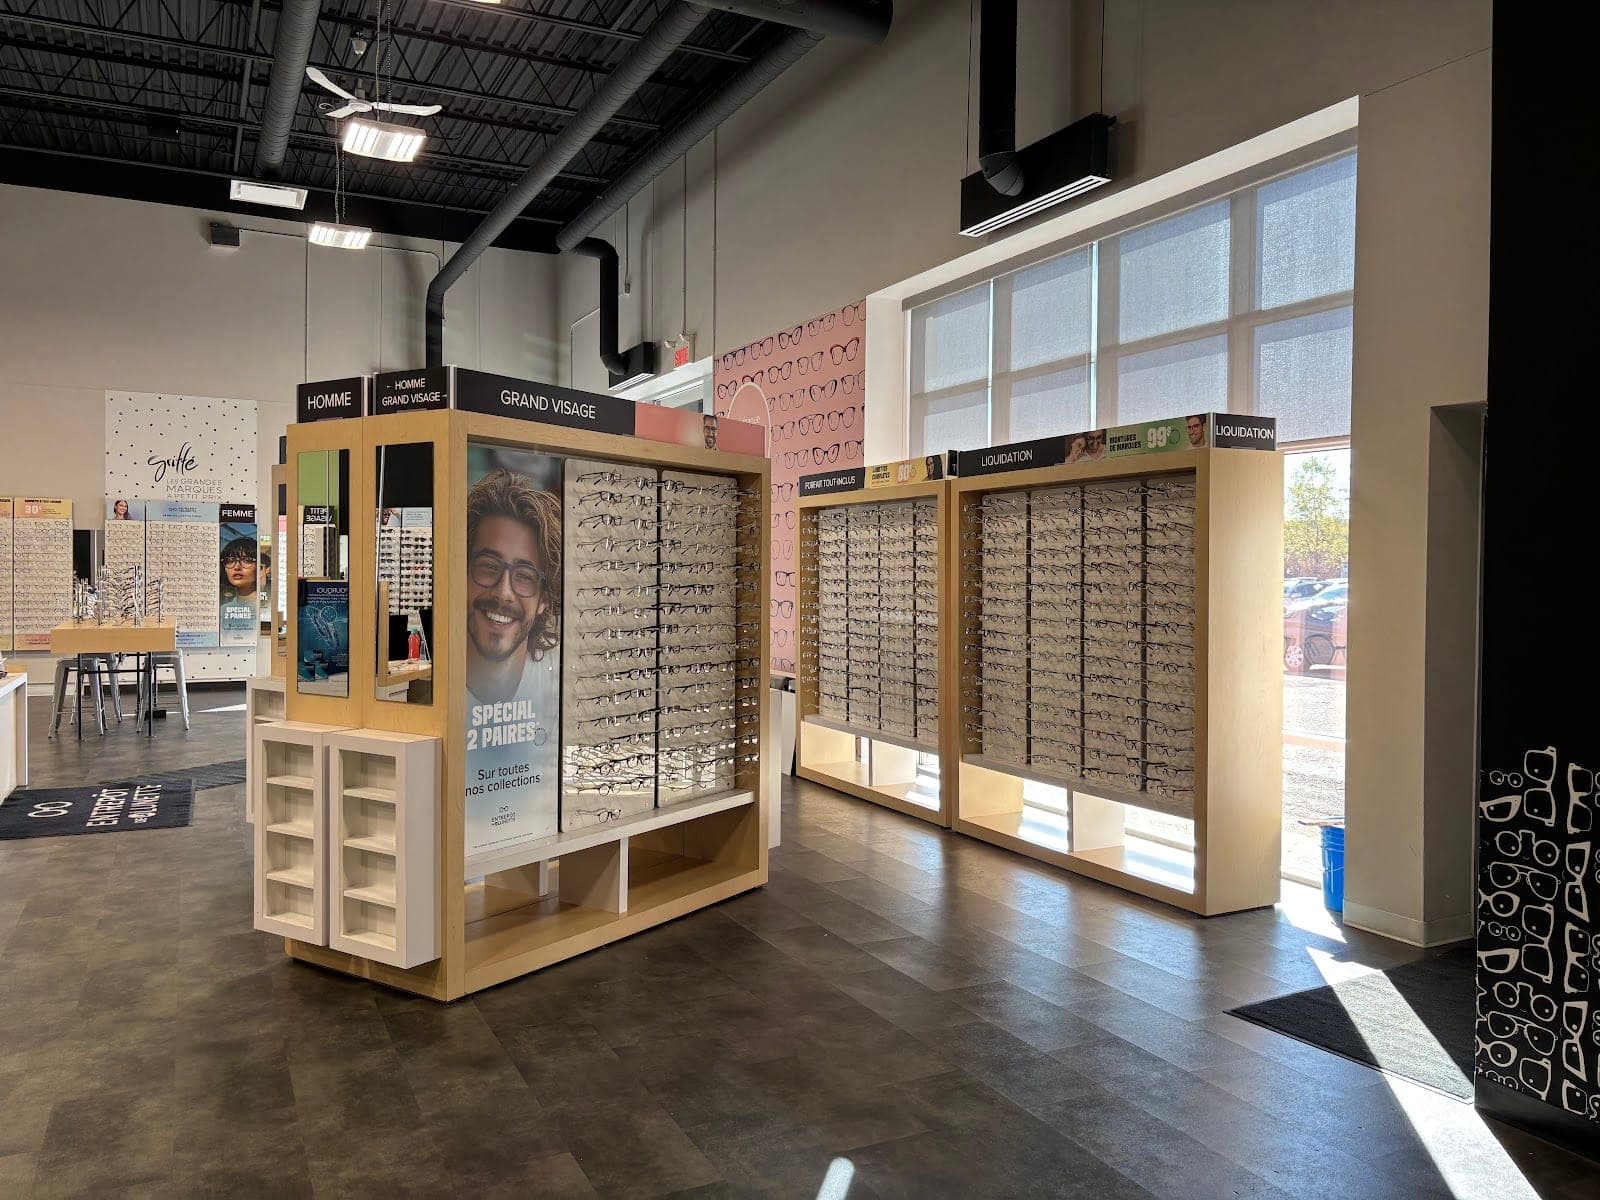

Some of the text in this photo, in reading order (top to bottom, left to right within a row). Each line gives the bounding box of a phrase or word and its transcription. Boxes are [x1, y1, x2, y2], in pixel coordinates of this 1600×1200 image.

[394, 377, 426, 390] HOMME
[307, 391, 352, 410] HOMME
[381, 391, 441, 407] GRAND VISAGE
[500, 389, 596, 420] GRAND VISAGE
[1215, 423, 1274, 440] LIQUIDATION
[981, 450, 1033, 467] LIQUIDATION
[166, 485, 223, 494] MARQUES
[222, 509, 254, 519] FEMME
[472, 700, 536, 727] SPÉCIAL
[467, 729, 478, 750] 2
[478, 763, 530, 781] Sur toutes
[465, 774, 541, 797] nos collections
